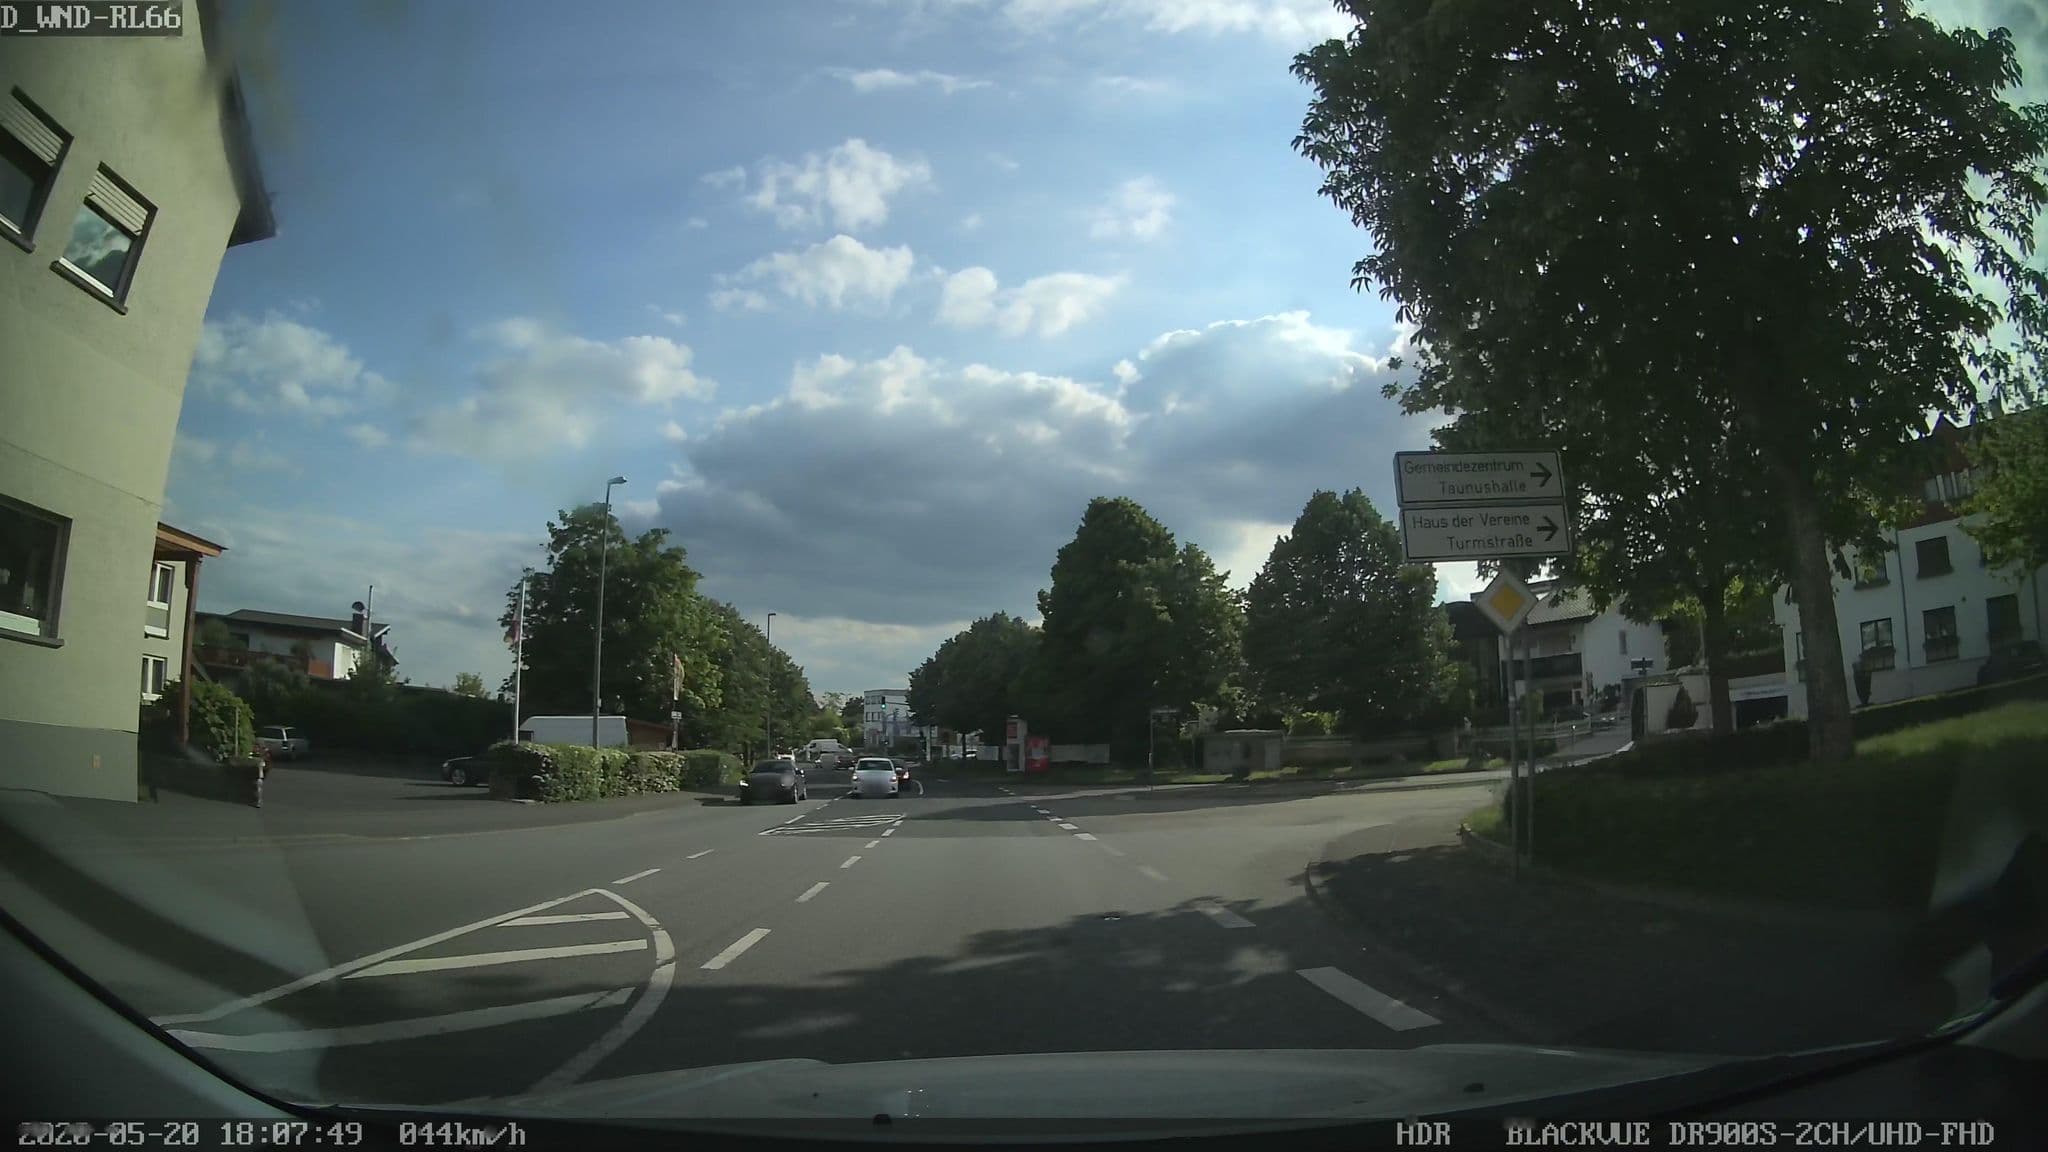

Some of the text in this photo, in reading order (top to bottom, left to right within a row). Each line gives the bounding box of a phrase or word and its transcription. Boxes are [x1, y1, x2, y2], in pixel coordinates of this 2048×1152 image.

[1404, 460, 1524, 474] Gemeindezentrum
[1439, 480, 1527, 496] Taunushalle
[1412, 512, 1531, 529] Haus der Vereine
[1447, 535, 1533, 551] Turmstraße
